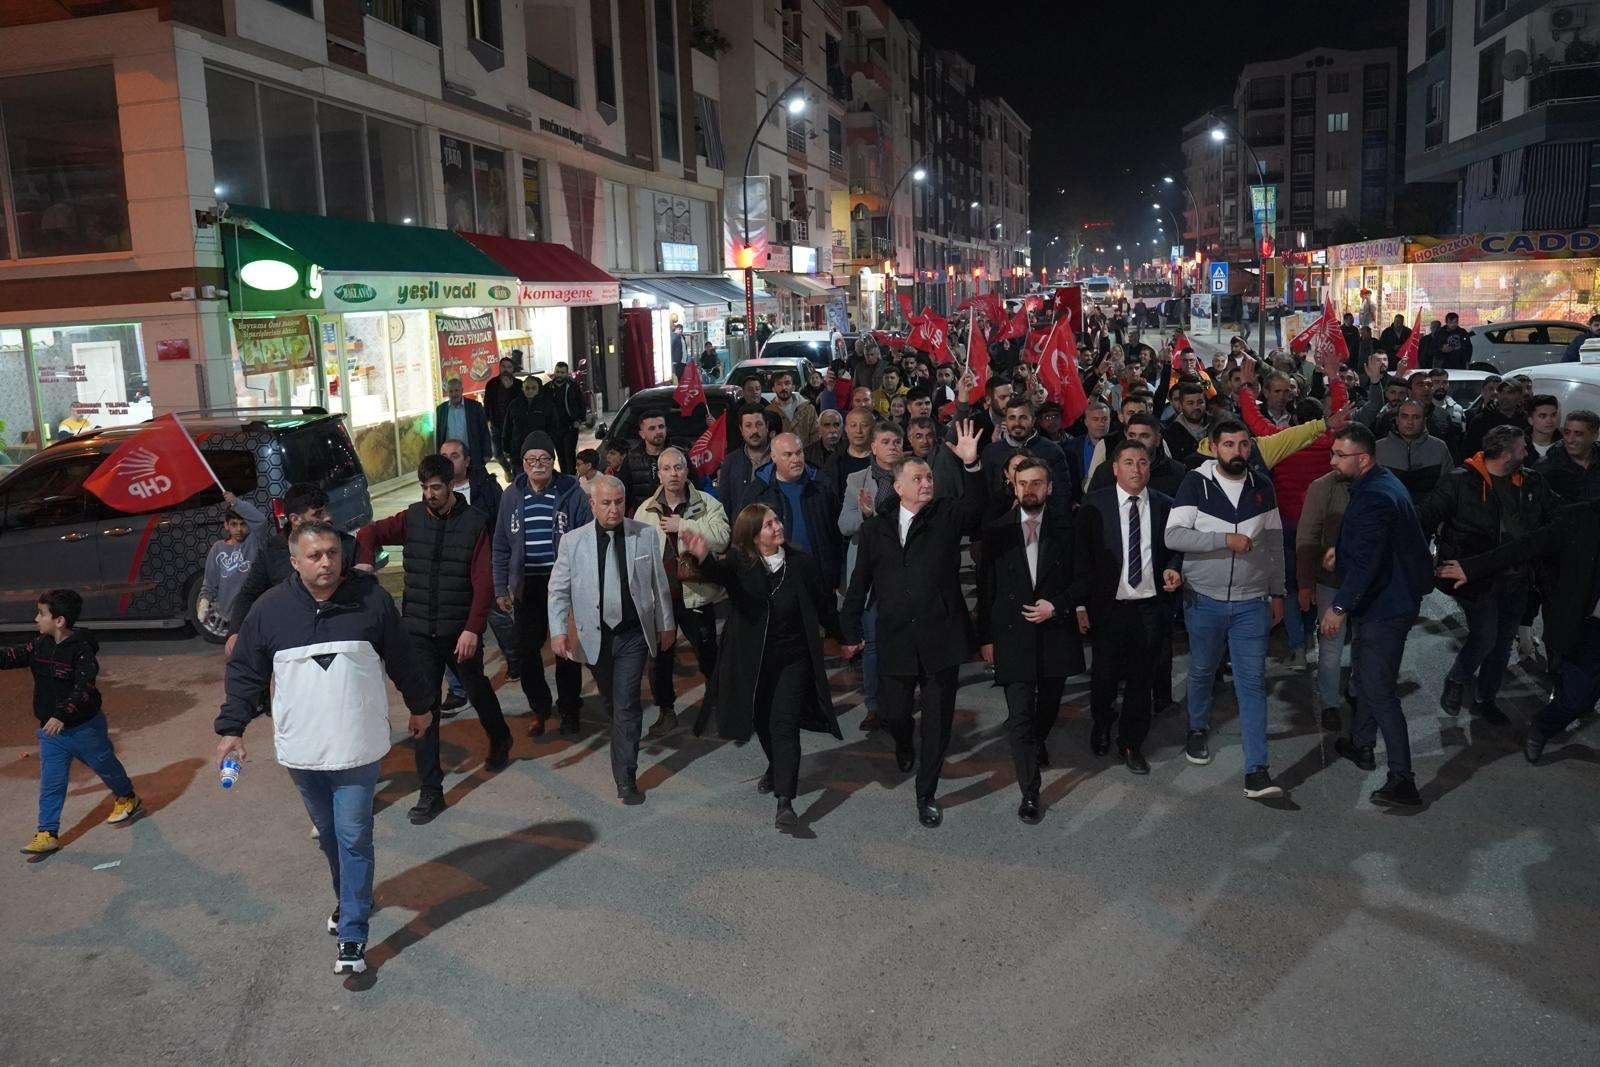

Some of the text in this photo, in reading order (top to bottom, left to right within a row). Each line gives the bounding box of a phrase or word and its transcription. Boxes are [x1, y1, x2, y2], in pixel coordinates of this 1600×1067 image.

[1339, 245, 1365, 261] CADDE
[1414, 236, 1477, 262] HOROZKÖY
[397, 281, 439, 304] yeşil
[443, 281, 476, 299] vadi
[1215, 281, 1223, 290] D
[523, 286, 593, 303] komagene
[447, 332, 468, 346] ÖZEL
